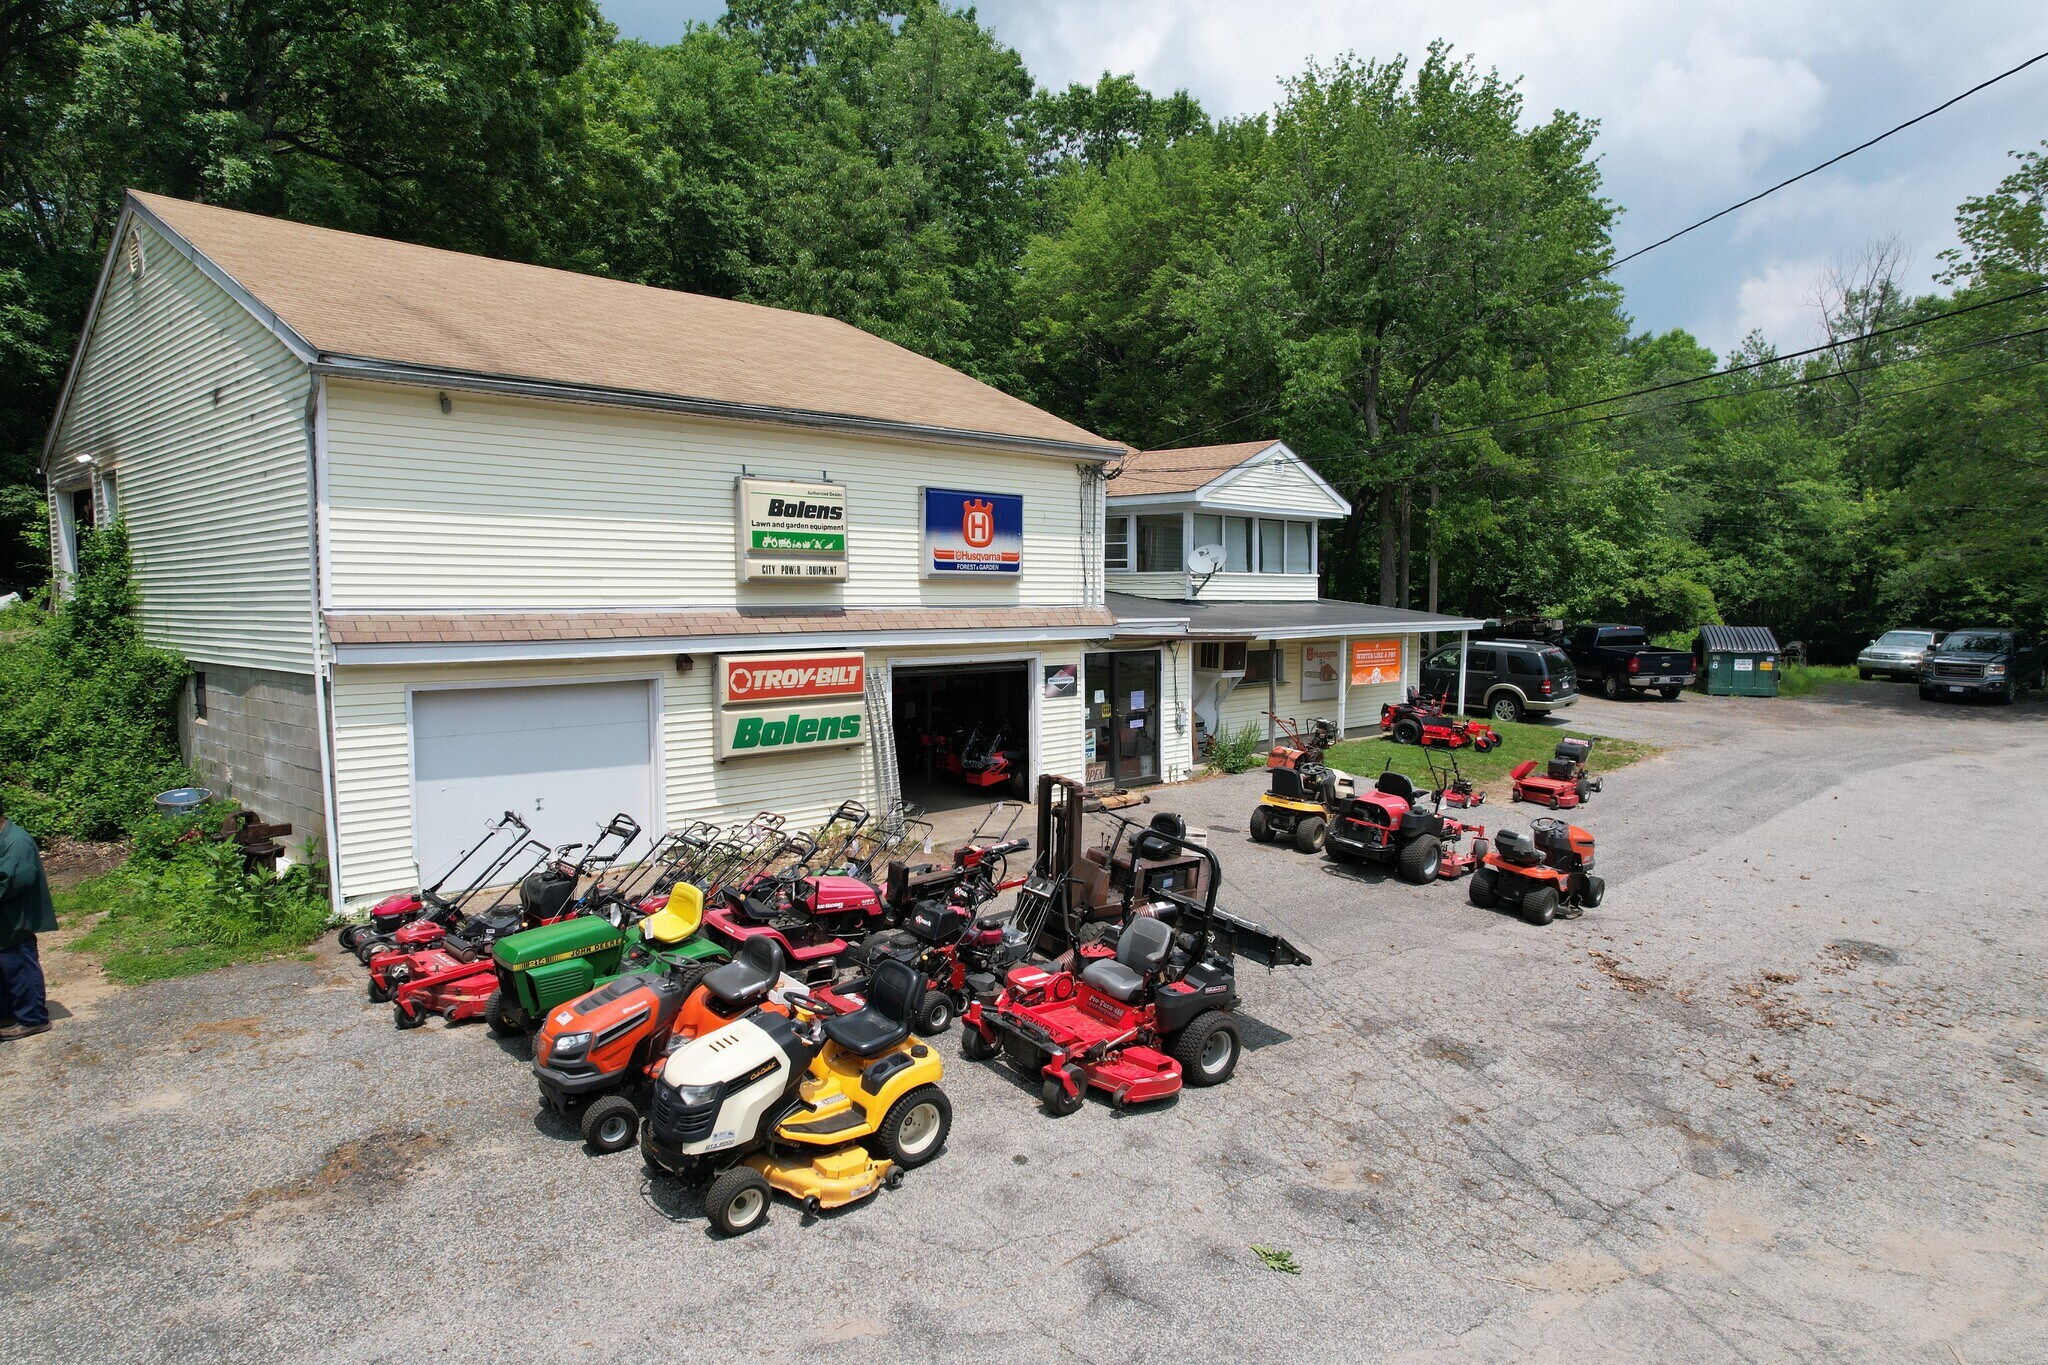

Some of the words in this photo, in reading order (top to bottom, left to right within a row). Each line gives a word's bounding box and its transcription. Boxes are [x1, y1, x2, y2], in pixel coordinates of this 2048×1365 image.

[768, 498, 844, 520] Bolens
[786, 522, 809, 530] garden
[961, 550, 1001, 562] Husqvarna
[761, 564, 776, 575] CITY
[781, 565, 801, 575] POWER
[806, 565, 837, 576] EQUIPMENT
[1356, 652, 1374, 660] WINTER
[1712, 660, 1719, 669] 8
[752, 665, 861, 691] TROY-BILT
[732, 714, 862, 749] Bolens
[528, 958, 547, 967] 214
[570, 947, 592, 957] JOHN
[594, 938, 622, 951] DEERE
[1020, 1012, 1061, 1038] GRAVELY
